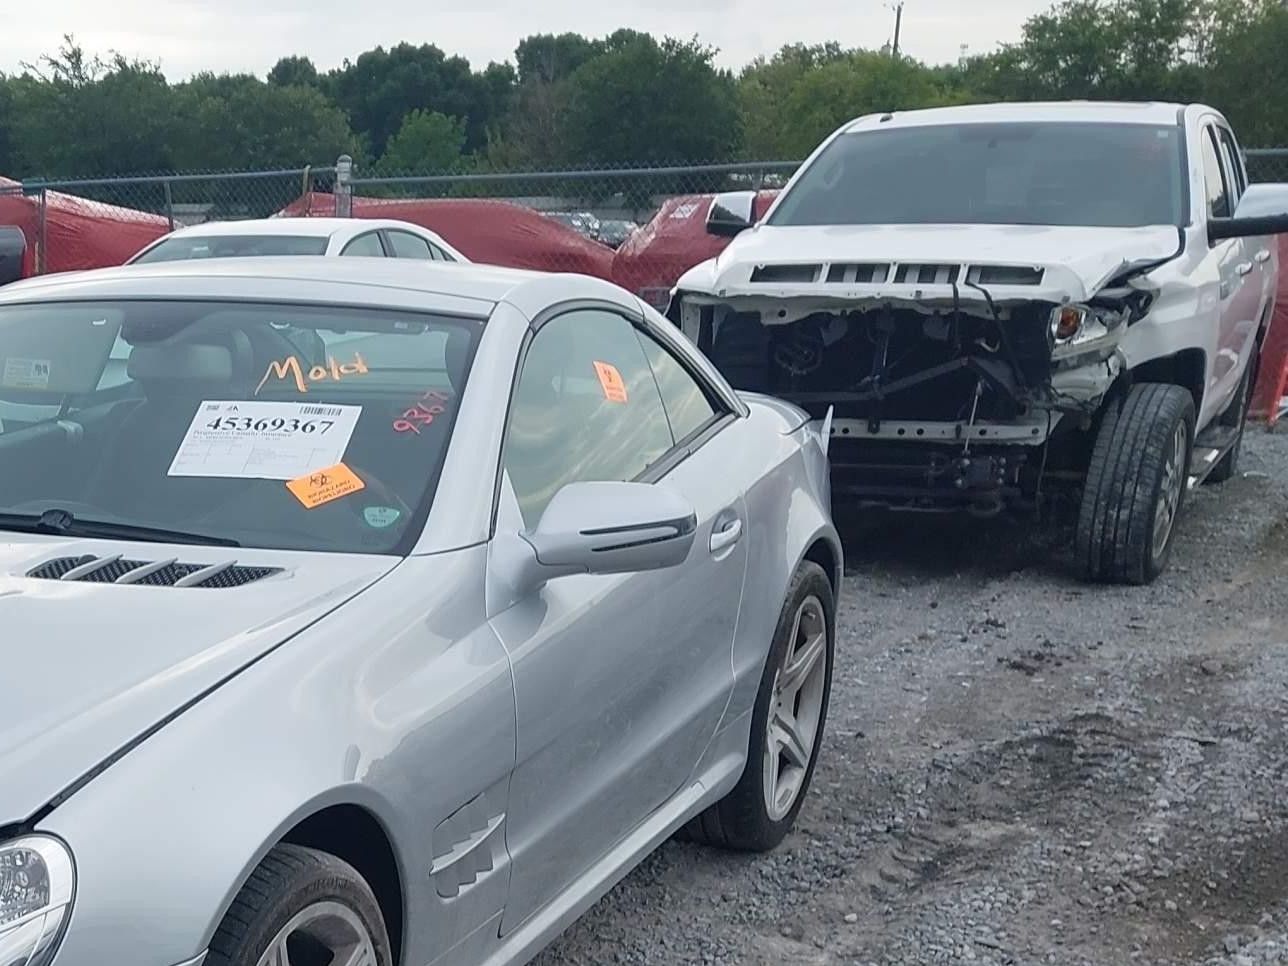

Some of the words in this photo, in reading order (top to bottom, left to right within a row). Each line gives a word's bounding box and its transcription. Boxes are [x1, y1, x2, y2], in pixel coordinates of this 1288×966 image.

[254, 352, 369, 396] Mold
[206, 416, 335, 435] 45369367
[393, 391, 449, 434] 9367
